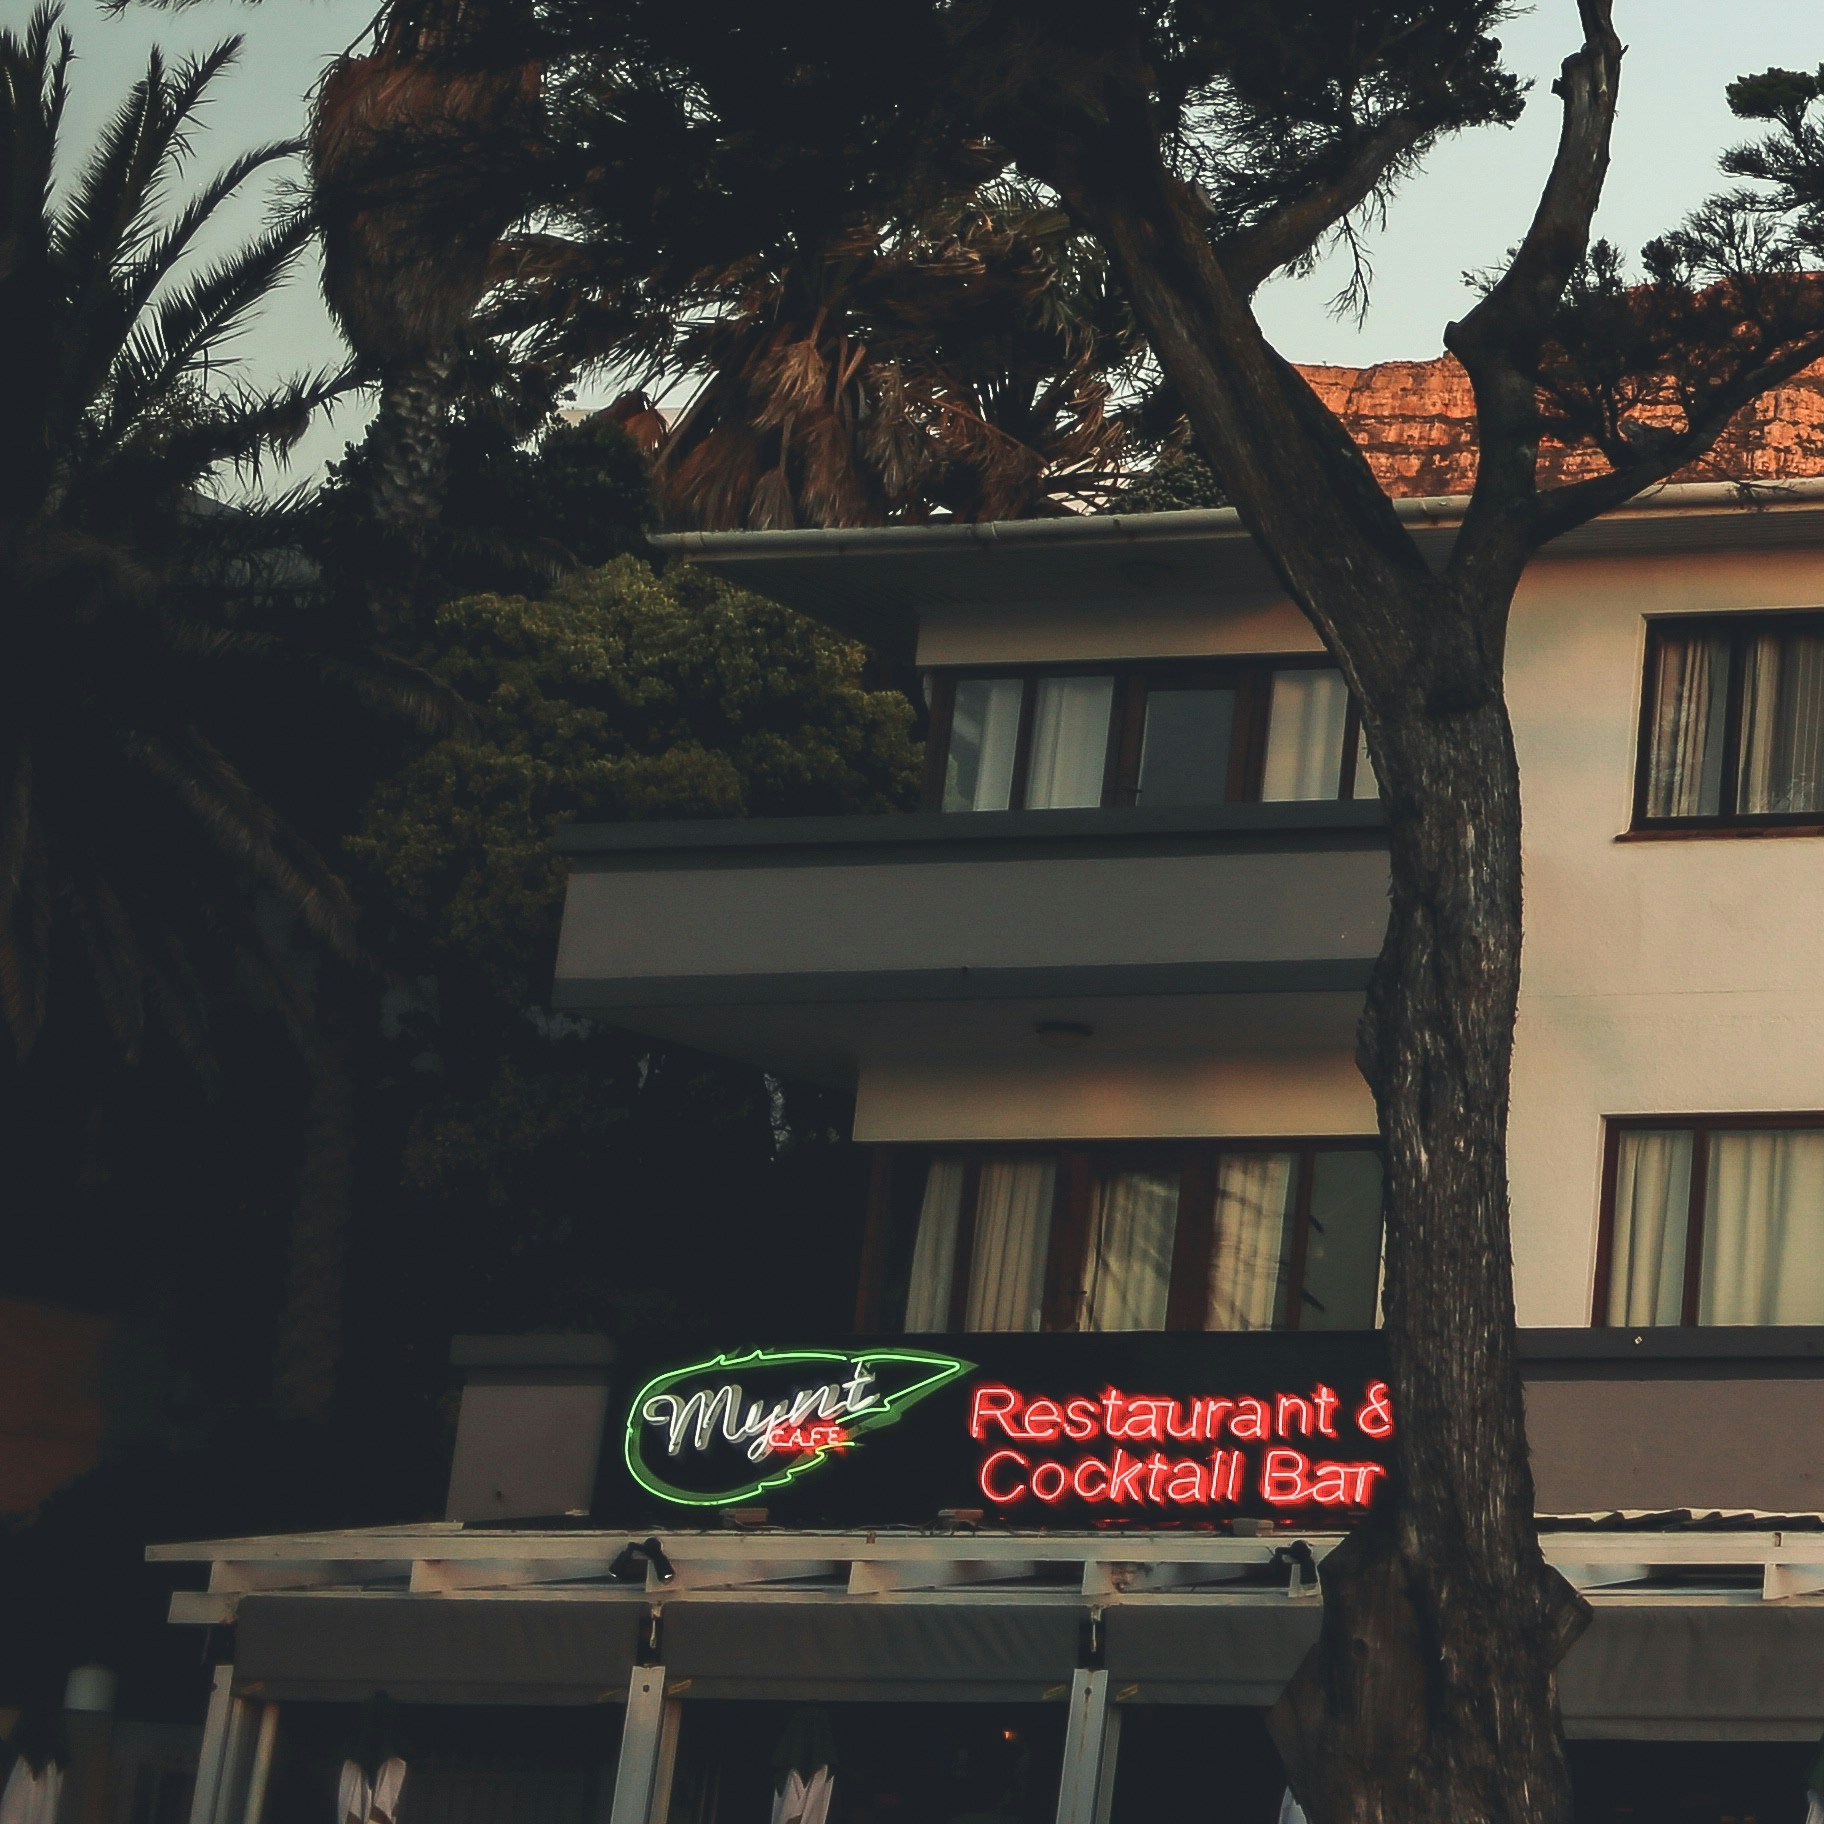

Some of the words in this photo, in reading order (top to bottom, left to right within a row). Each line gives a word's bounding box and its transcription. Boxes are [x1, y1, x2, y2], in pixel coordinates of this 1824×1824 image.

[642, 1360, 880, 1463] Mynt
[768, 1426, 842, 1448] CAFE
[971, 1385, 1336, 1439] Restaurant
[1358, 1382, 1390, 1435] &
[1264, 1450, 1381, 1503] Bar
